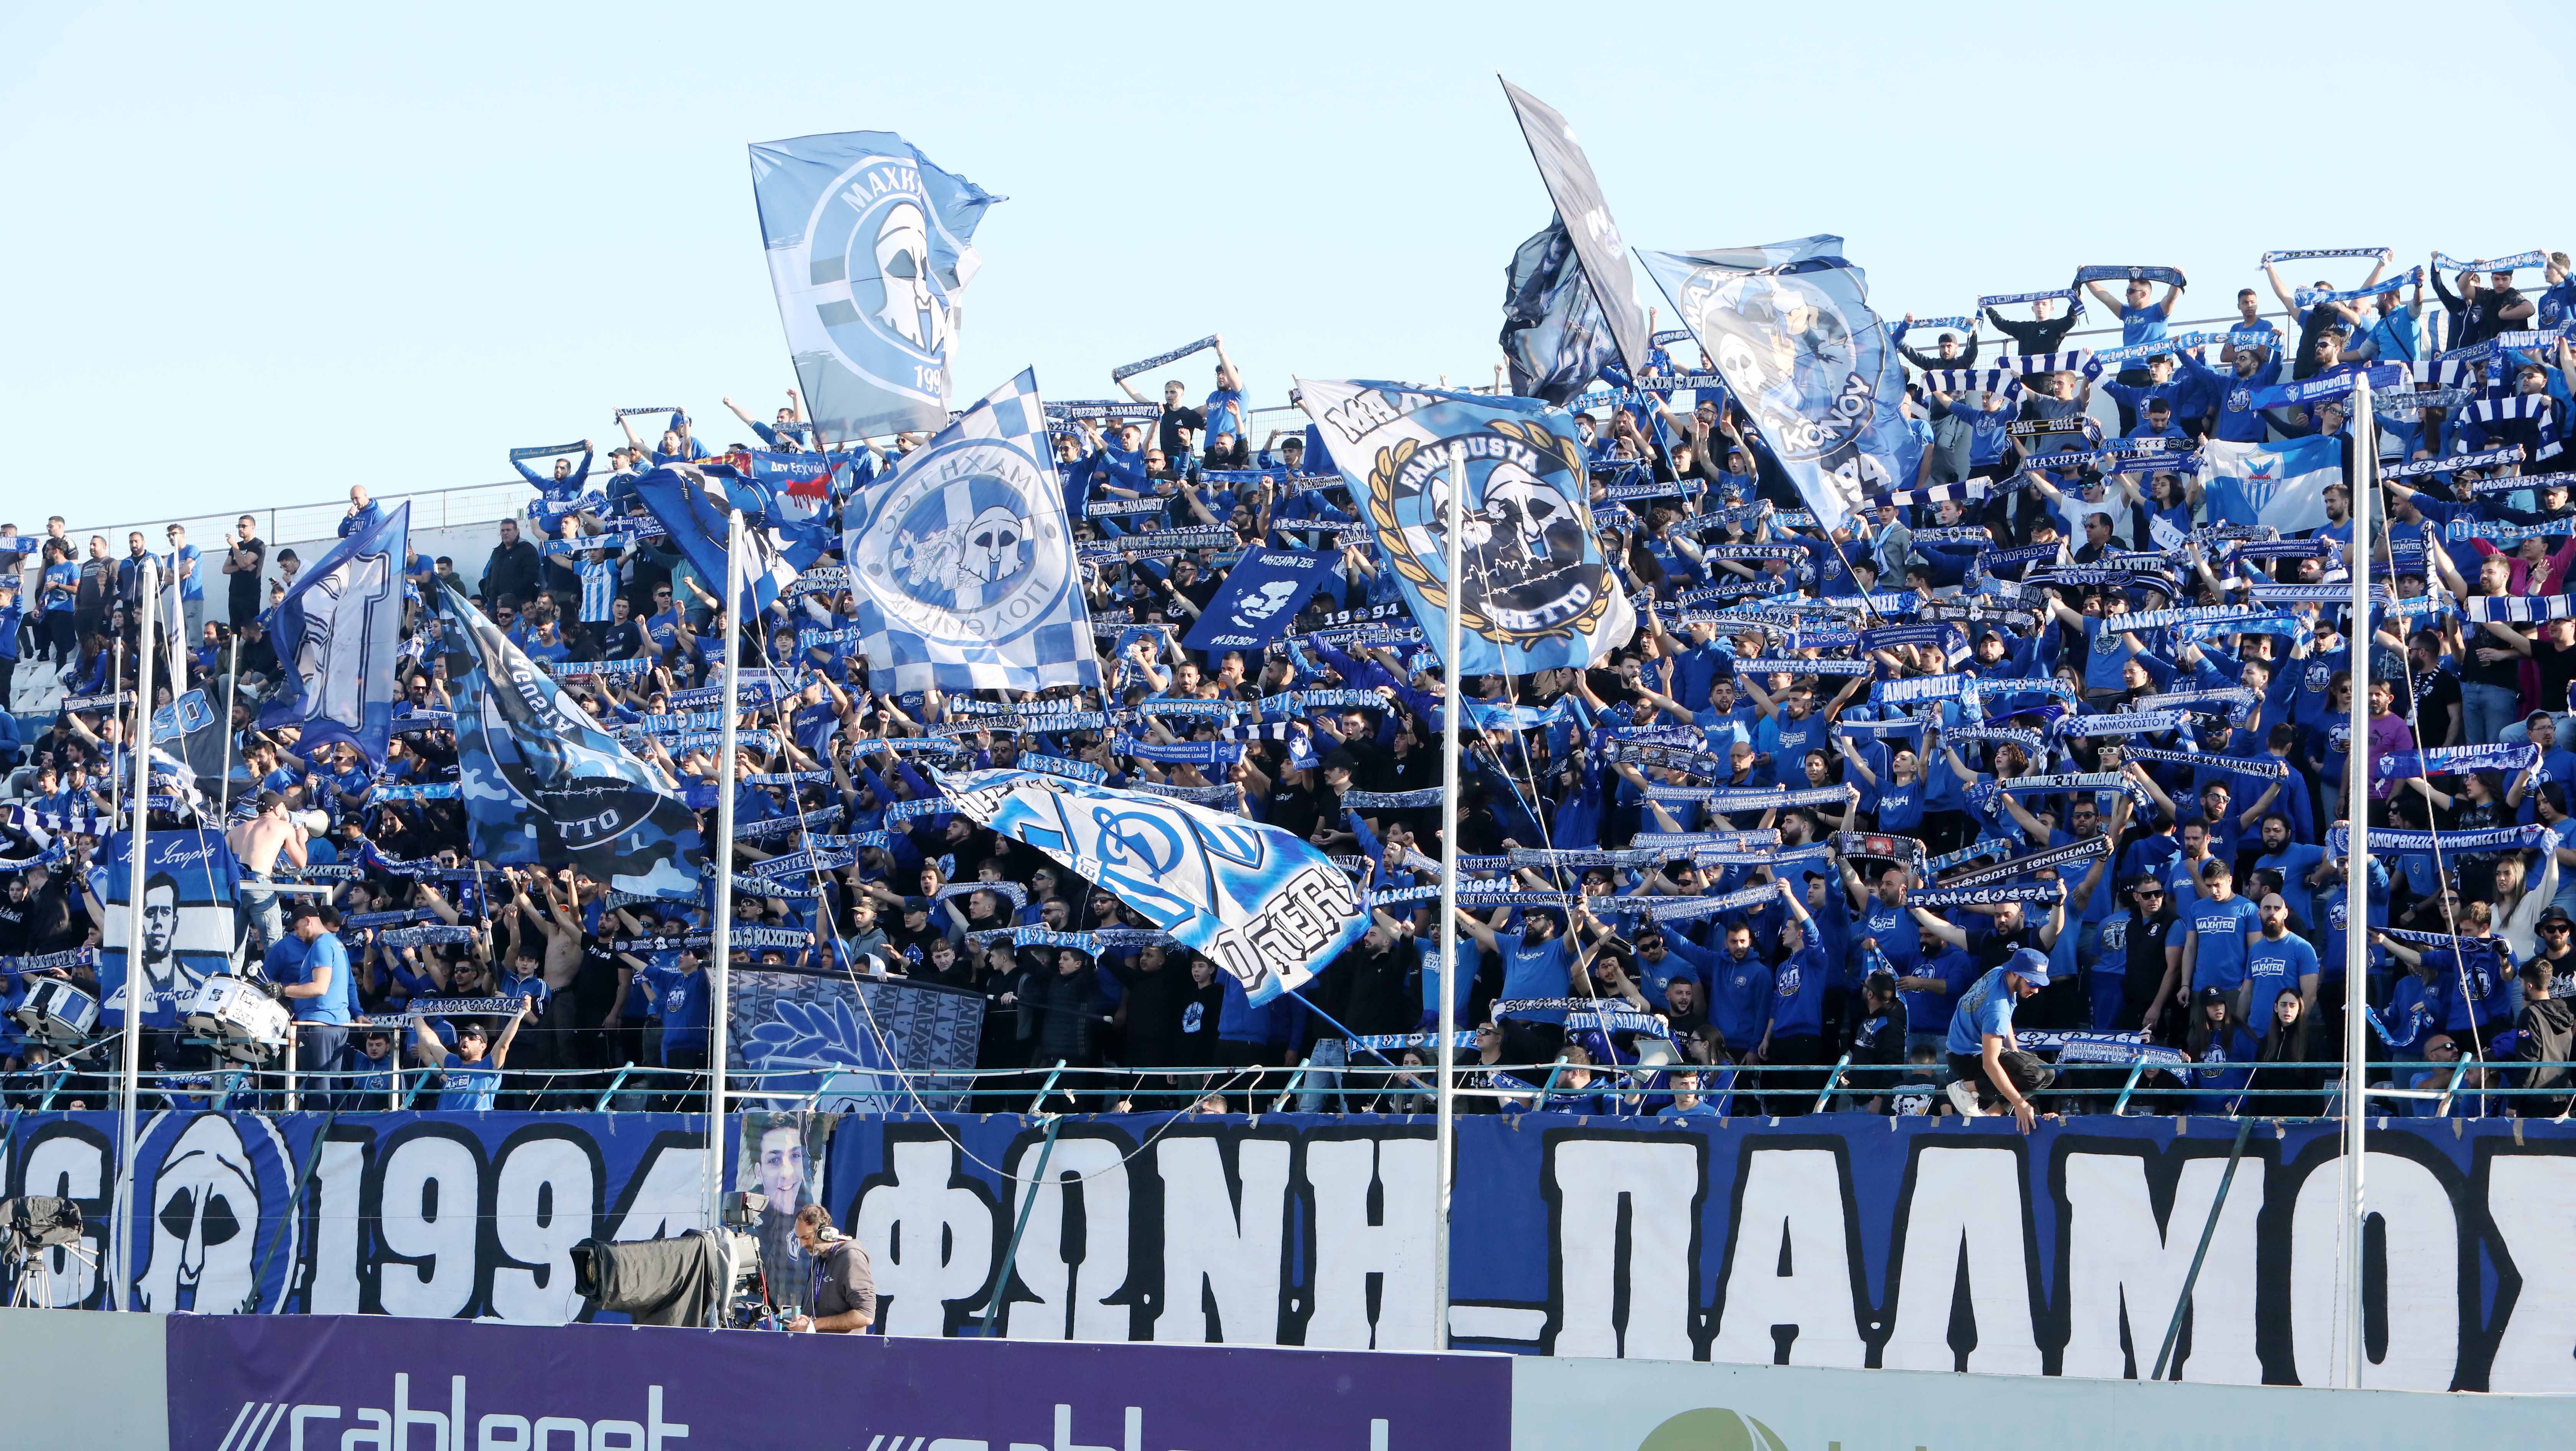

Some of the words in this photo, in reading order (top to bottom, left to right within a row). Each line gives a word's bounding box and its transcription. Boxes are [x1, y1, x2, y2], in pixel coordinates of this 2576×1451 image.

[1072, 407, 1106, 418] FREEDOM
[1112, 405, 1158, 417] FAMAGUSTA
[2011, 421, 2036, 434] 1911
[2049, 419, 2075, 431] 2011
[771, 461, 788, 472] Δεν
[790, 462, 826, 476] ξεχνώ!
[1089, 503, 1119, 516] FREEDOM
[1912, 529, 1943, 542] HENS
[549, 542, 559, 550] 19
[1211, 554, 1239, 565] Freedo
[1991, 544, 2059, 564] ΑΝΟΡΘΩΣΙΣ
[1480, 583, 1592, 630] GHETTO
[1325, 610, 1349, 625] 19
[1372, 605, 1398, 620] 94
[1802, 632, 1857, 643] ΑΝΟΡΘΩ
[1733, 660, 1805, 674] FAMAGUSTA
[1817, 661, 1867, 674] GHETTO
[1883, 675, 1960, 702] ΑΝΟΡΘΩΣΙΣ
[953, 696, 996, 713] BLUE
[1016, 698, 1070, 714] UNION
[1873, 727, 1888, 737] 1911
[2092, 718, 2167, 732] ΑΜΜΟΧΩΣΤΟΥ
[1164, 752, 1191, 760] CONFERENCE
[1166, 745, 1200, 753] FAMAGUSTA
[2027, 841, 2103, 870] ΕΘΝΙΚΙΣΜΟΣ
[1456, 857, 1508, 871] ANORTHO
[1466, 877, 1508, 893] 1994
[1914, 886, 2049, 906] FAMAGUSTA
[599, 951, 611, 960] 94
[855, 1136, 1444, 1352] ΦΩΝΗ
